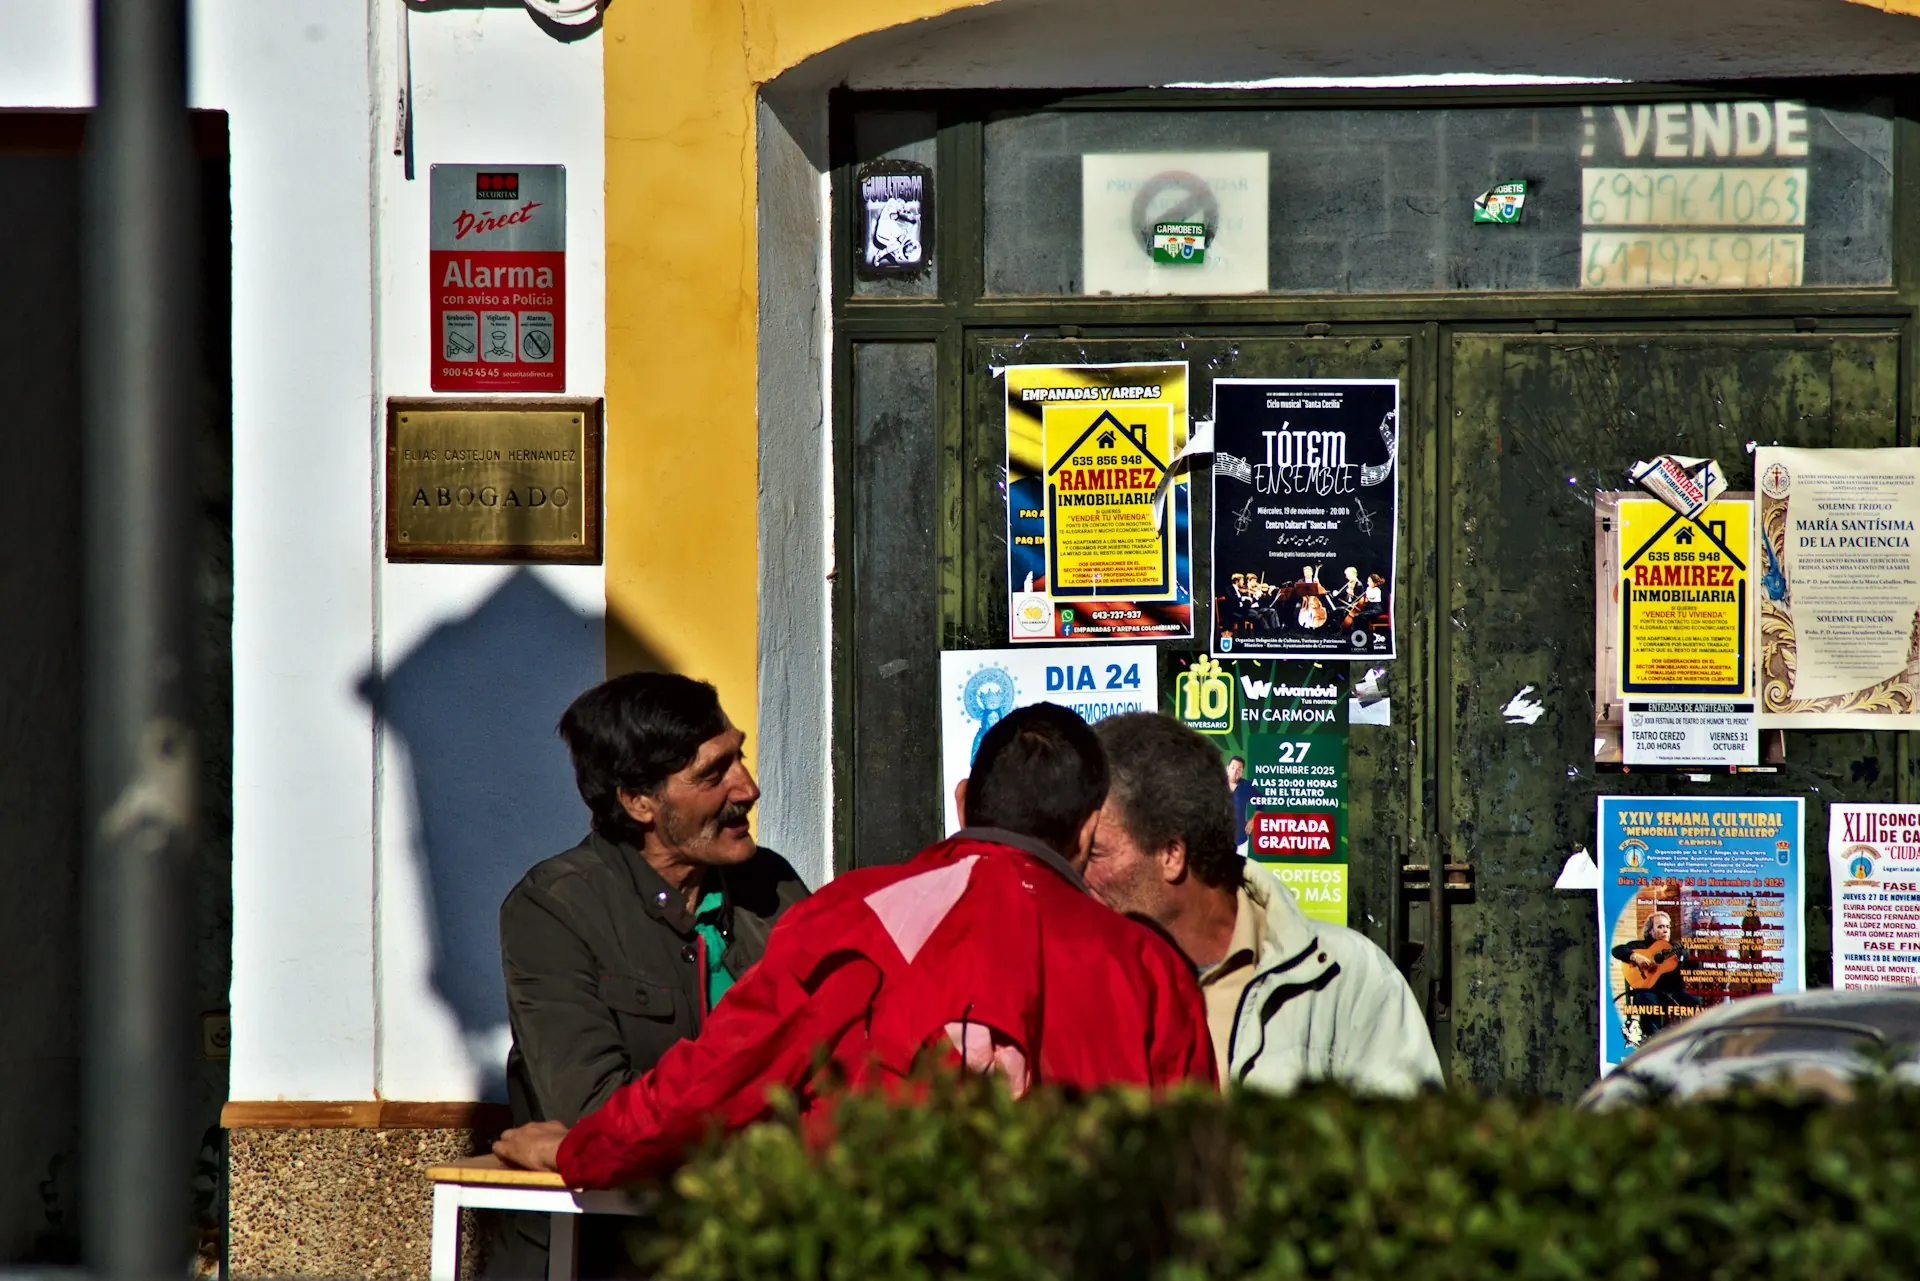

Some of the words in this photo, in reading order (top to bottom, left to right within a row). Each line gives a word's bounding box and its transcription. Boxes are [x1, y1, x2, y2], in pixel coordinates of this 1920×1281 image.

[1613, 100, 1808, 156] VENDE
[453, 200, 544, 240] Direct
[1156, 224, 1202, 234] CARMOBETIS
[442, 259, 554, 288] Alarma
[442, 295, 464, 304] con
[468, 292, 500, 304] aviso
[502, 296, 510, 305] a
[513, 292, 553, 305] Policía
[442, 368, 460, 376] 900
[463, 368, 473, 376] 45
[475, 368, 486, 376] 45
[488, 368, 499, 376] 45
[1022, 387, 1098, 401] EMPANADAS
[1100, 387, 1111, 400] Y
[1112, 386, 1161, 399] AREPAS
[1267, 400, 1280, 408] Ciclo
[1280, 400, 1301, 408] musical
[404, 450, 437, 461] ELIAS
[444, 450, 500, 461] CASTEJON
[508, 450, 576, 461] HERNANDEZ
[1072, 456, 1093, 466] 635
[1097, 456, 1117, 465] 856
[1121, 455, 1142, 464] 948
[1060, 468, 1156, 490] RAMIREZ
[1254, 464, 1358, 496] ENSEMBLE
[1662, 460, 1704, 503] RAMIREZ
[1657, 466, 1695, 508] INMOBILIARIA
[412, 486, 569, 507] ABOGADO
[1020, 510, 1038, 518] PAQ
[1284, 507, 1289, 515] 19
[1290, 507, 1297, 515] de
[1298, 507, 1324, 515] noviembre
[1330, 507, 1345, 515] 20:00
[1266, 521, 1284, 529] Centro
[1285, 521, 1307, 529] Cultural
[1796, 518, 1838, 530] MARÍA
[1842, 518, 1914, 530] SANTÍSIMA
[1015, 536, 1034, 545] PAQ
[1800, 536, 1817, 547] DE
[1820, 536, 1836, 547] LA
[1840, 536, 1909, 547] PACIENCIA
[1648, 552, 1669, 561] 635
[1673, 552, 1695, 561] 856
[1699, 552, 1720, 561] 948
[1634, 565, 1734, 586] RAMIREZ
[1633, 590, 1735, 602] INMOBILIARIA
[1046, 665, 1096, 691] DIA
[1106, 663, 1141, 689] 24
[1273, 684, 1337, 698] vivamóvil
[1183, 679, 1228, 720] 10
[1648, 704, 1683, 712] ENTRADAS
[1684, 704, 1693, 712] DE
[1695, 704, 1735, 712] ANFITEATRO
[1241, 709, 1259, 722] EN
[1262, 709, 1336, 722] CARMONA
[1632, 732, 1657, 740] TEATRO
[1659, 732, 1686, 740] CEREZO
[1710, 732, 1738, 741] VIERNES
[1740, 732, 1748, 741] 31
[1279, 741, 1311, 763] 27
[1637, 742, 1655, 751] 21,00
[1255, 765, 1309, 775] NOVIEMBRE
[1311, 765, 1335, 775] 2025
[1278, 779, 1304, 787] 20:00
[1307, 779, 1337, 787] HORAS
[1265, 788, 1276, 796] EN
[1279, 788, 1289, 796] EL
[1290, 788, 1324, 796] TEATRO
[1250, 797, 1285, 805] CEREZO
[1287, 798, 1339, 808] (CARMONA)
[1618, 812, 1653, 826] XXIV
[1656, 812, 1710, 826] SEMANA
[1713, 812, 1783, 827] CULTURAL
[1260, 819, 1329, 833] ENTRADA
[1681, 827, 1716, 837] PEPITA
[1842, 813, 1877, 842] XLII
[1879, 813, 1920, 826] CONC
[1880, 830, 1897, 843] DE
[1259, 836, 1330, 850] GRATUITA
[1273, 869, 1341, 883] SORTEOS
[1305, 884, 1341, 902] MÁS
[1864, 942, 1895, 950] FASE
[1624, 1005, 1665, 1016] MANUEL
